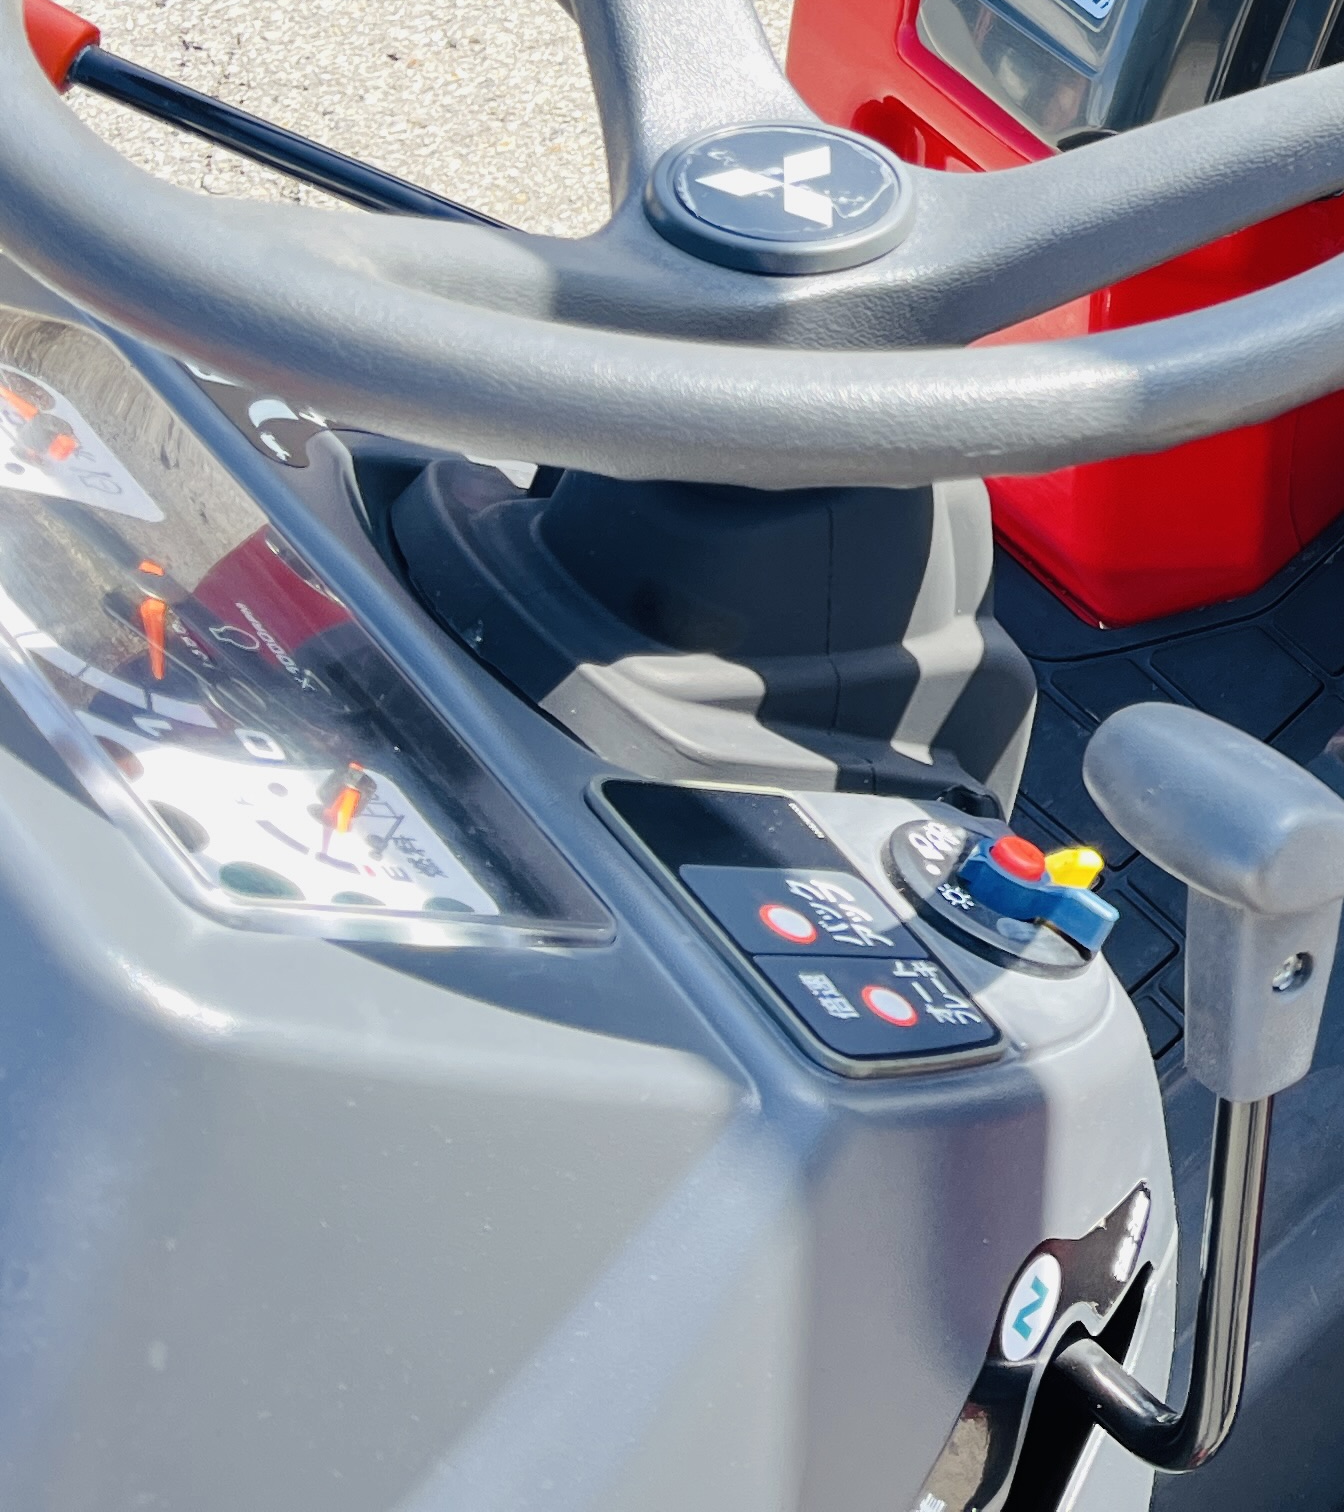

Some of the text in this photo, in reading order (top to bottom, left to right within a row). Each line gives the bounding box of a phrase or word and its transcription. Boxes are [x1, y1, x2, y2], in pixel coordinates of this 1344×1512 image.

[233, 729, 285, 757] 0
[786, 879, 865, 946] バック
[810, 880, 894, 946] アップ
[798, 971, 860, 1020] 倍速
[893, 961, 956, 1024] オート
[911, 961, 981, 1024] ブレーキ
[1012, 1275, 1050, 1340] N
